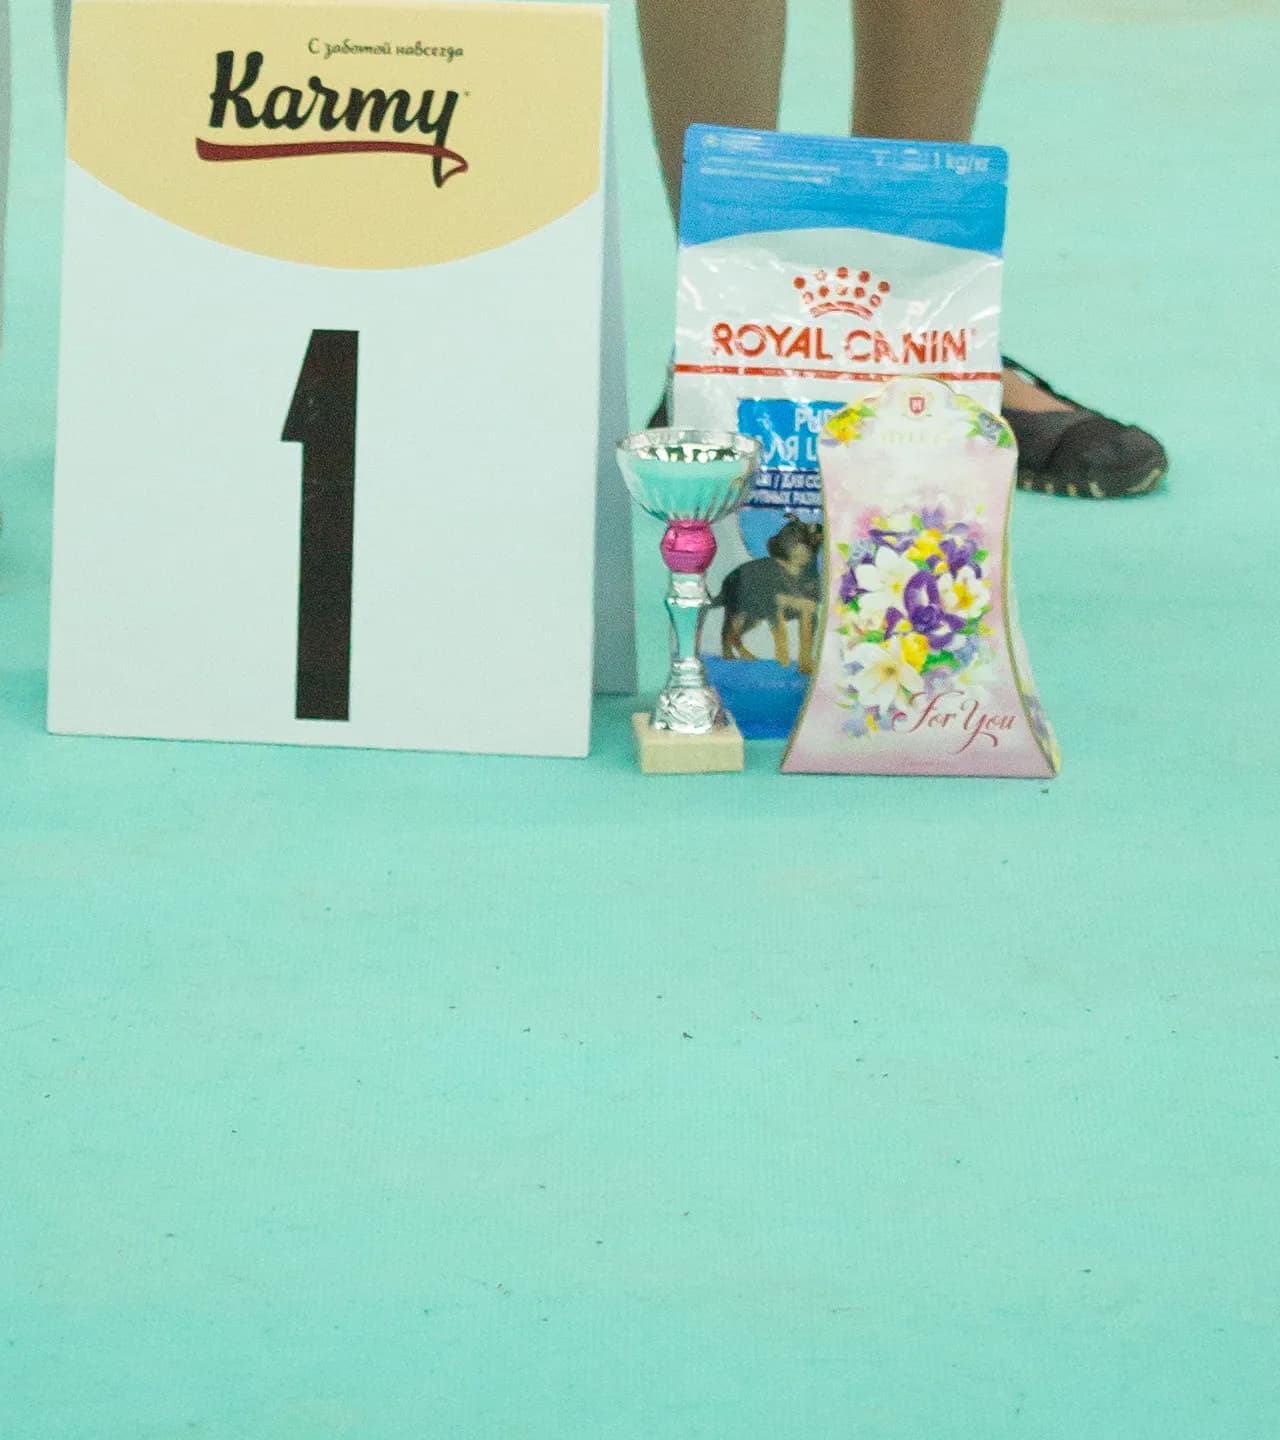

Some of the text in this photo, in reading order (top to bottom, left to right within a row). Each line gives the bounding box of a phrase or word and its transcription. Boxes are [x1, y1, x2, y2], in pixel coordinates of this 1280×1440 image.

[308, 37, 464, 63] С заботой навсегда
[209, 50, 459, 188] Karmy
[712, 321, 968, 365] ROYAL CANIN
[281, 329, 359, 721] 1
[892, 690, 1017, 755] For You
